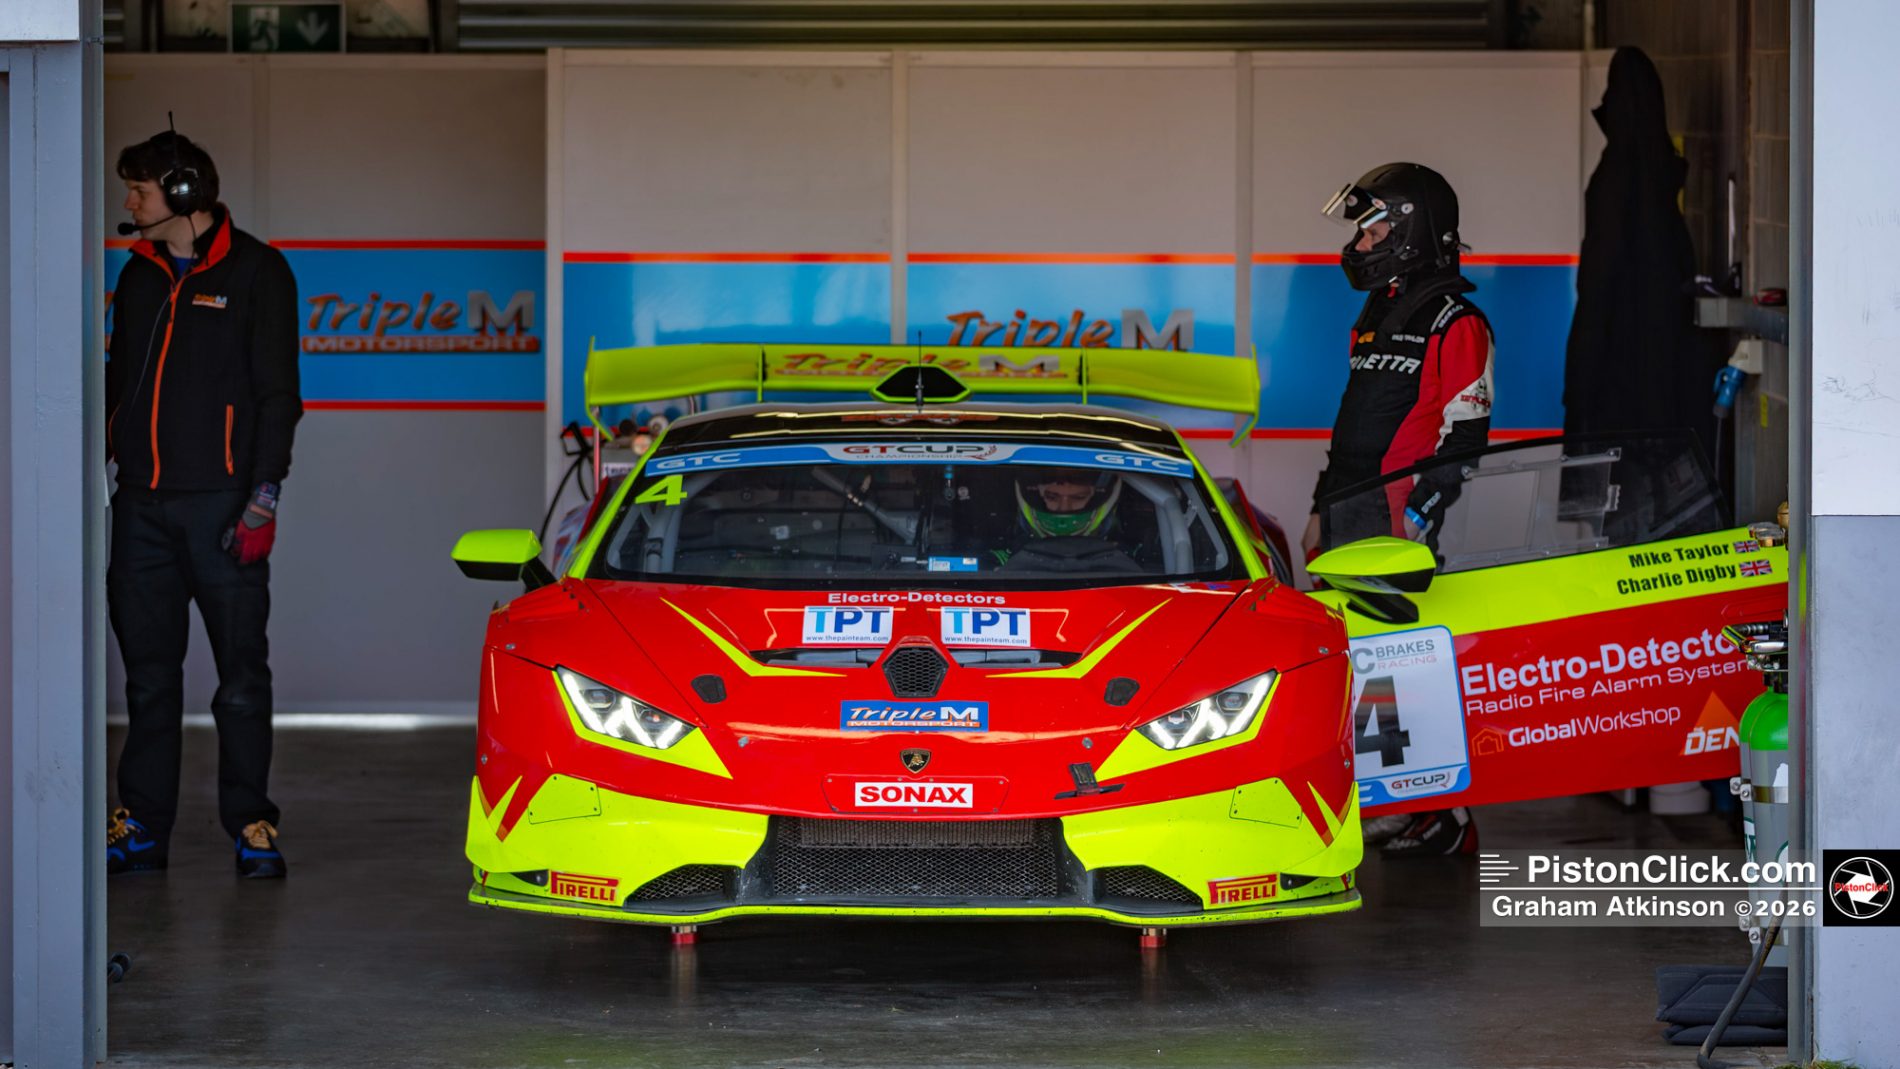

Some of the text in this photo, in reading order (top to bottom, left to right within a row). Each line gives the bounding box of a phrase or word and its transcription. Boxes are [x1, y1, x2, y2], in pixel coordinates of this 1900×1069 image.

[304, 336, 536, 352] MOTORSPORT
[656, 453, 741, 469] GTC
[1095, 454, 1180, 471] GTC
[635, 474, 688, 506] 4
[1628, 543, 1730, 569] Mike Taylor
[1617, 563, 1737, 595] Charlie Digby
[828, 592, 1006, 604] Electro-Detectors
[807, 606, 890, 634] TPT
[944, 608, 1027, 636] TPT
[944, 636, 1028, 644] www.thepainteam.com
[1375, 639, 1435, 659] BRAKES
[1377, 654, 1438, 670] RACING
[1461, 628, 1739, 697] Electro-Detecto
[1466, 658, 1750, 716] Radio Fire Alarm Syste
[847, 720, 981, 728] MOTORSPORT
[850, 706, 937, 722] Triple
[1354, 675, 1412, 768] 4
[860, 786, 968, 804] SONAX
[551, 871, 620, 902] PIRELLI
[1208, 873, 1278, 904] PIRELLI
